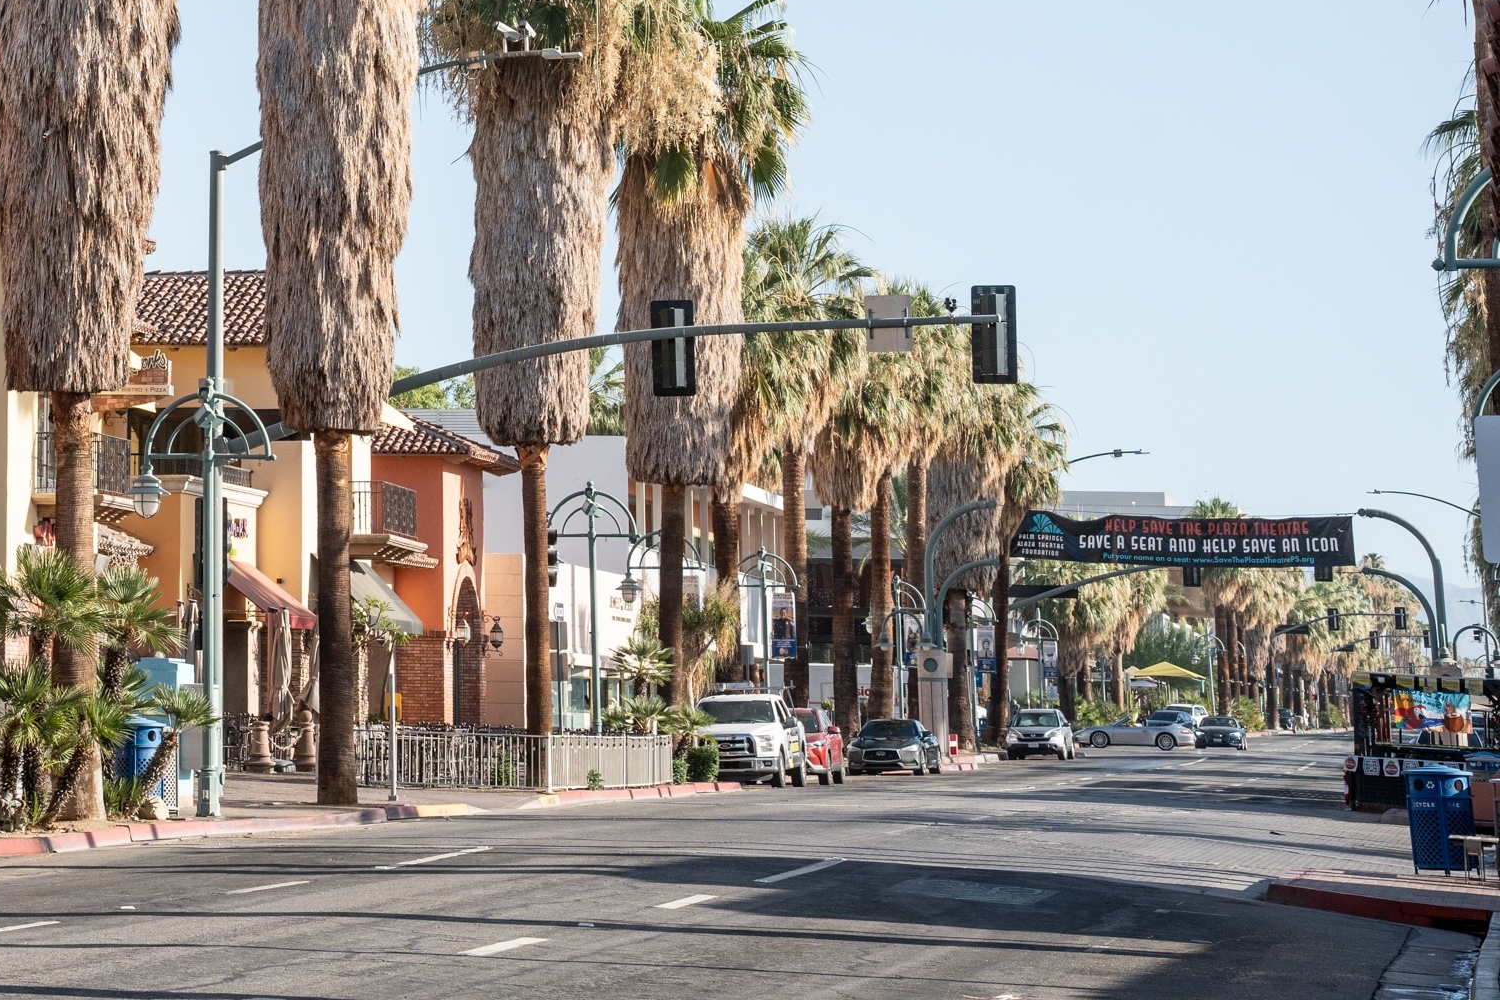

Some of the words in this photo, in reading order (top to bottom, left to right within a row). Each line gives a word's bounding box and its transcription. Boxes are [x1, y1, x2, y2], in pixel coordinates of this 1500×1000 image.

[141, 349, 169, 371] orks
[1105, 518, 1137, 533] HELP
[1142, 520, 1174, 535] SAVE
[1179, 521, 1202, 537] THE
[1207, 521, 1248, 536] PLAZA
[1253, 521, 1310, 536] THEATRE
[1037, 534, 1064, 542] SPRINGS
[1078, 534, 1112, 549] SAVE
[1116, 534, 1125, 550] A
[1130, 535, 1164, 552] SEAT
[1169, 537, 1197, 553] AND
[1202, 538, 1237, 554] HELP
[1242, 538, 1277, 554] SAVE
[1282, 537, 1301, 553] AN
[1305, 536, 1340, 553] ICON
[1017, 540, 1036, 548] PLAZA
[1038, 541, 1065, 550] THEATRE
[1021, 548, 1060, 557] FOUNDATION
[1102, 552, 1115, 560] Put
[1115, 553, 1132, 561] your
[1133, 554, 1154, 562] name
[1192, 555, 1315, 564] www.SaveThePlazaTheatrePS.org
